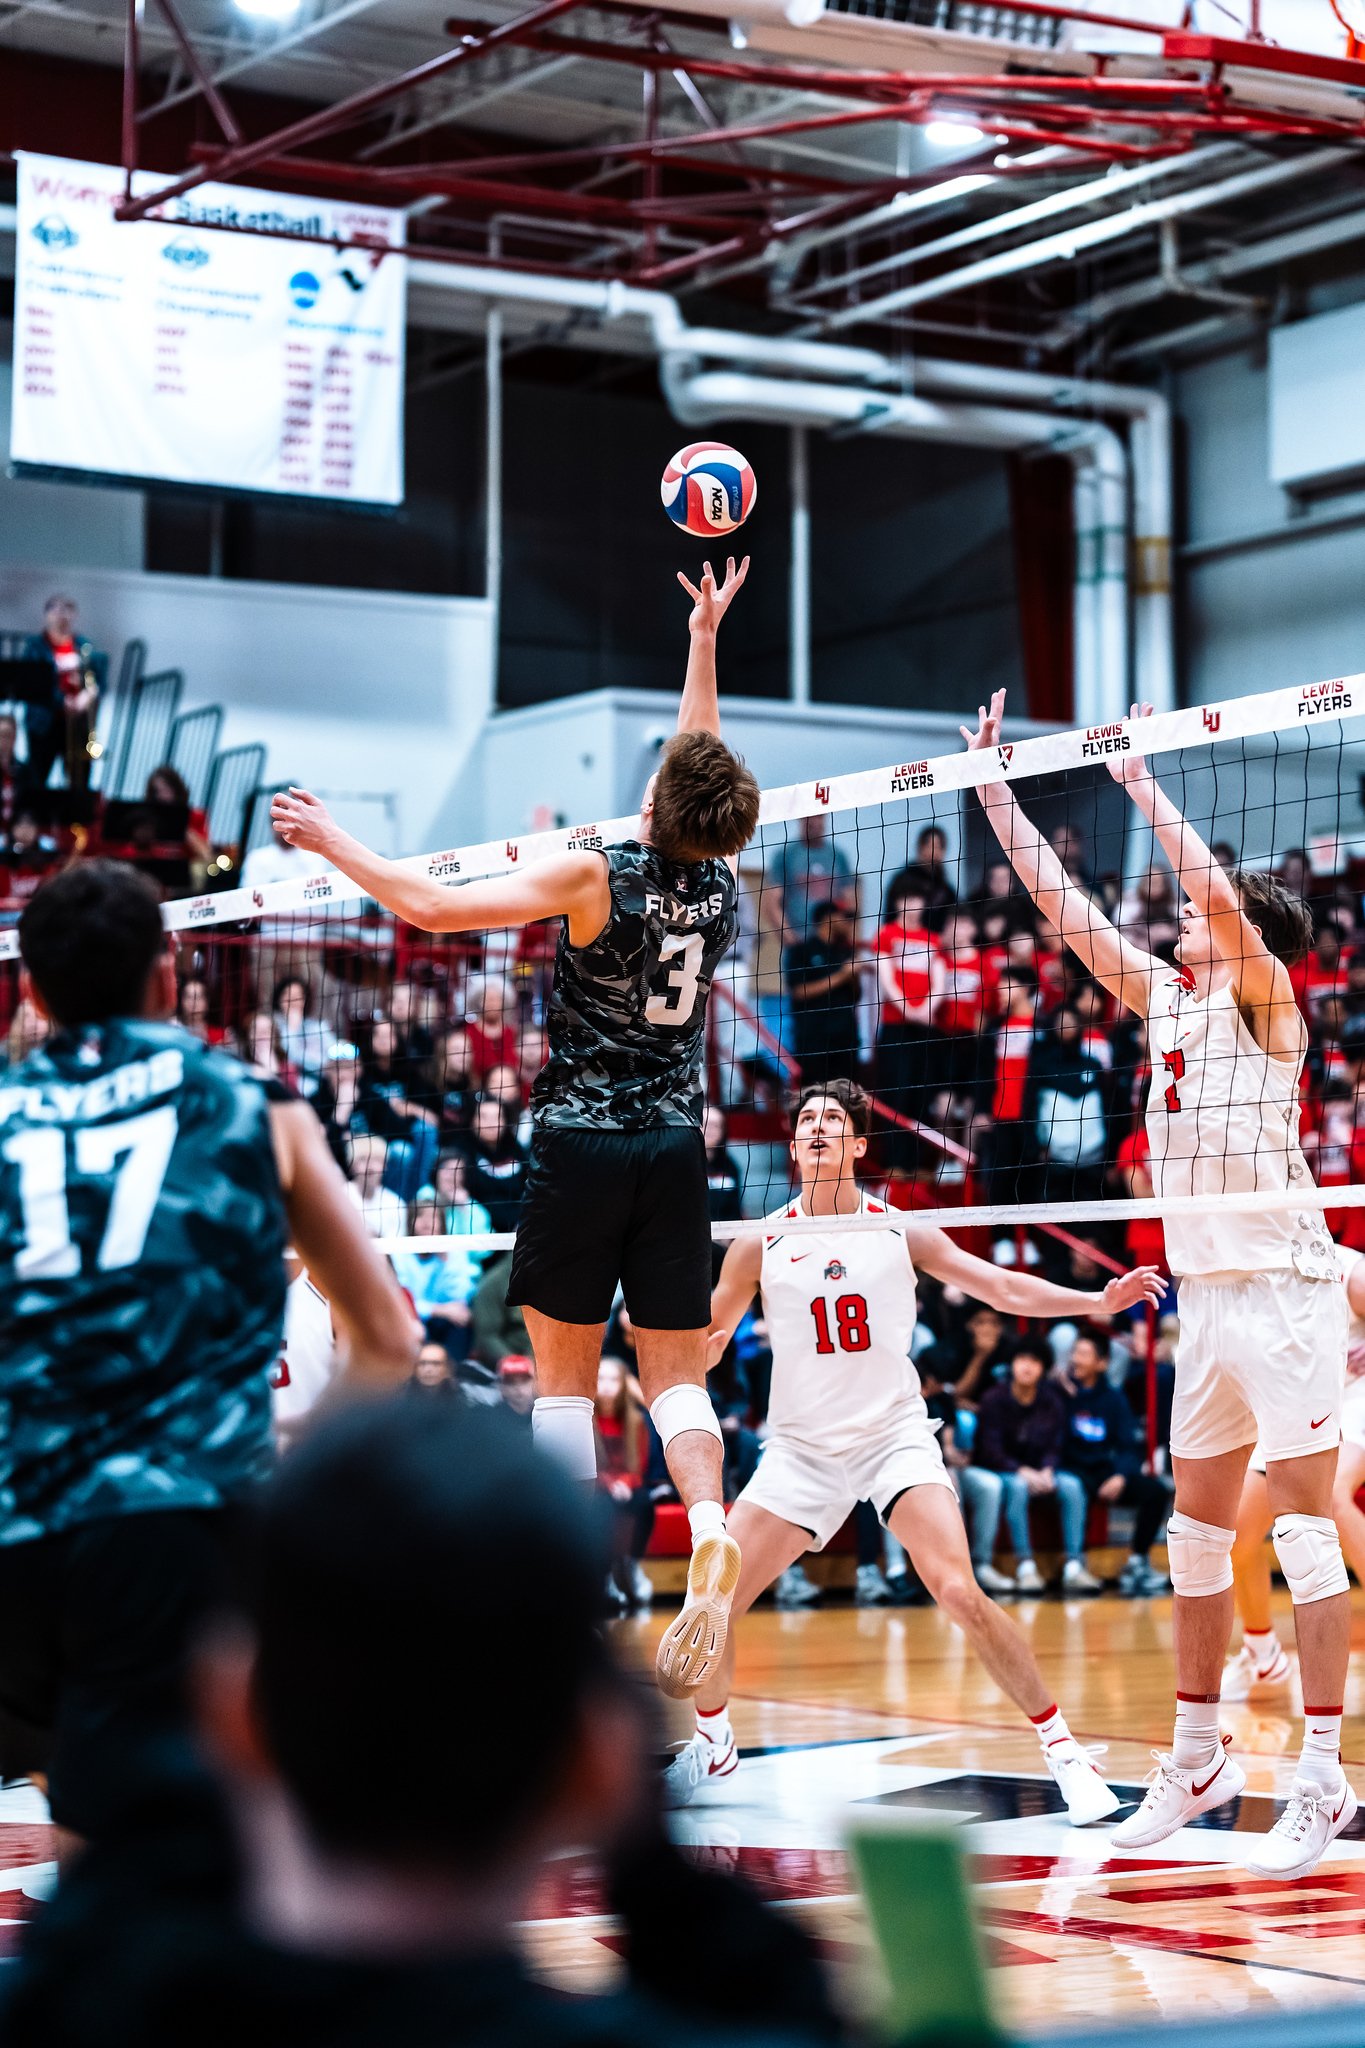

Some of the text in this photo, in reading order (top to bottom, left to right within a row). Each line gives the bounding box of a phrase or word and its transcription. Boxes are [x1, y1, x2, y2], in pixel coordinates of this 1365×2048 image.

[711, 487, 722, 521] NCAA
[1302, 680, 1344, 699] LEWIS
[1298, 693, 1352, 717] FLYERS
[1086, 723, 1123, 741] LEWIS
[1082, 736, 1131, 758] FLYERS
[894, 761, 928, 778] LEWIS
[891, 774, 934, 793] FLYERS
[570, 825, 597, 839] LEWIS
[567, 836, 603, 851] FLYERS
[431, 851, 456, 864] LEWIS
[428, 862, 461, 877] FLYERS
[304, 885, 333, 900] FLYERS
[645, 893, 722, 925] FLYERS
[644, 932, 706, 1026] 3
[0, 1049, 184, 1127] FLYERS
[2, 1104, 179, 1280] 17
[810, 1293, 872, 1355] 18
